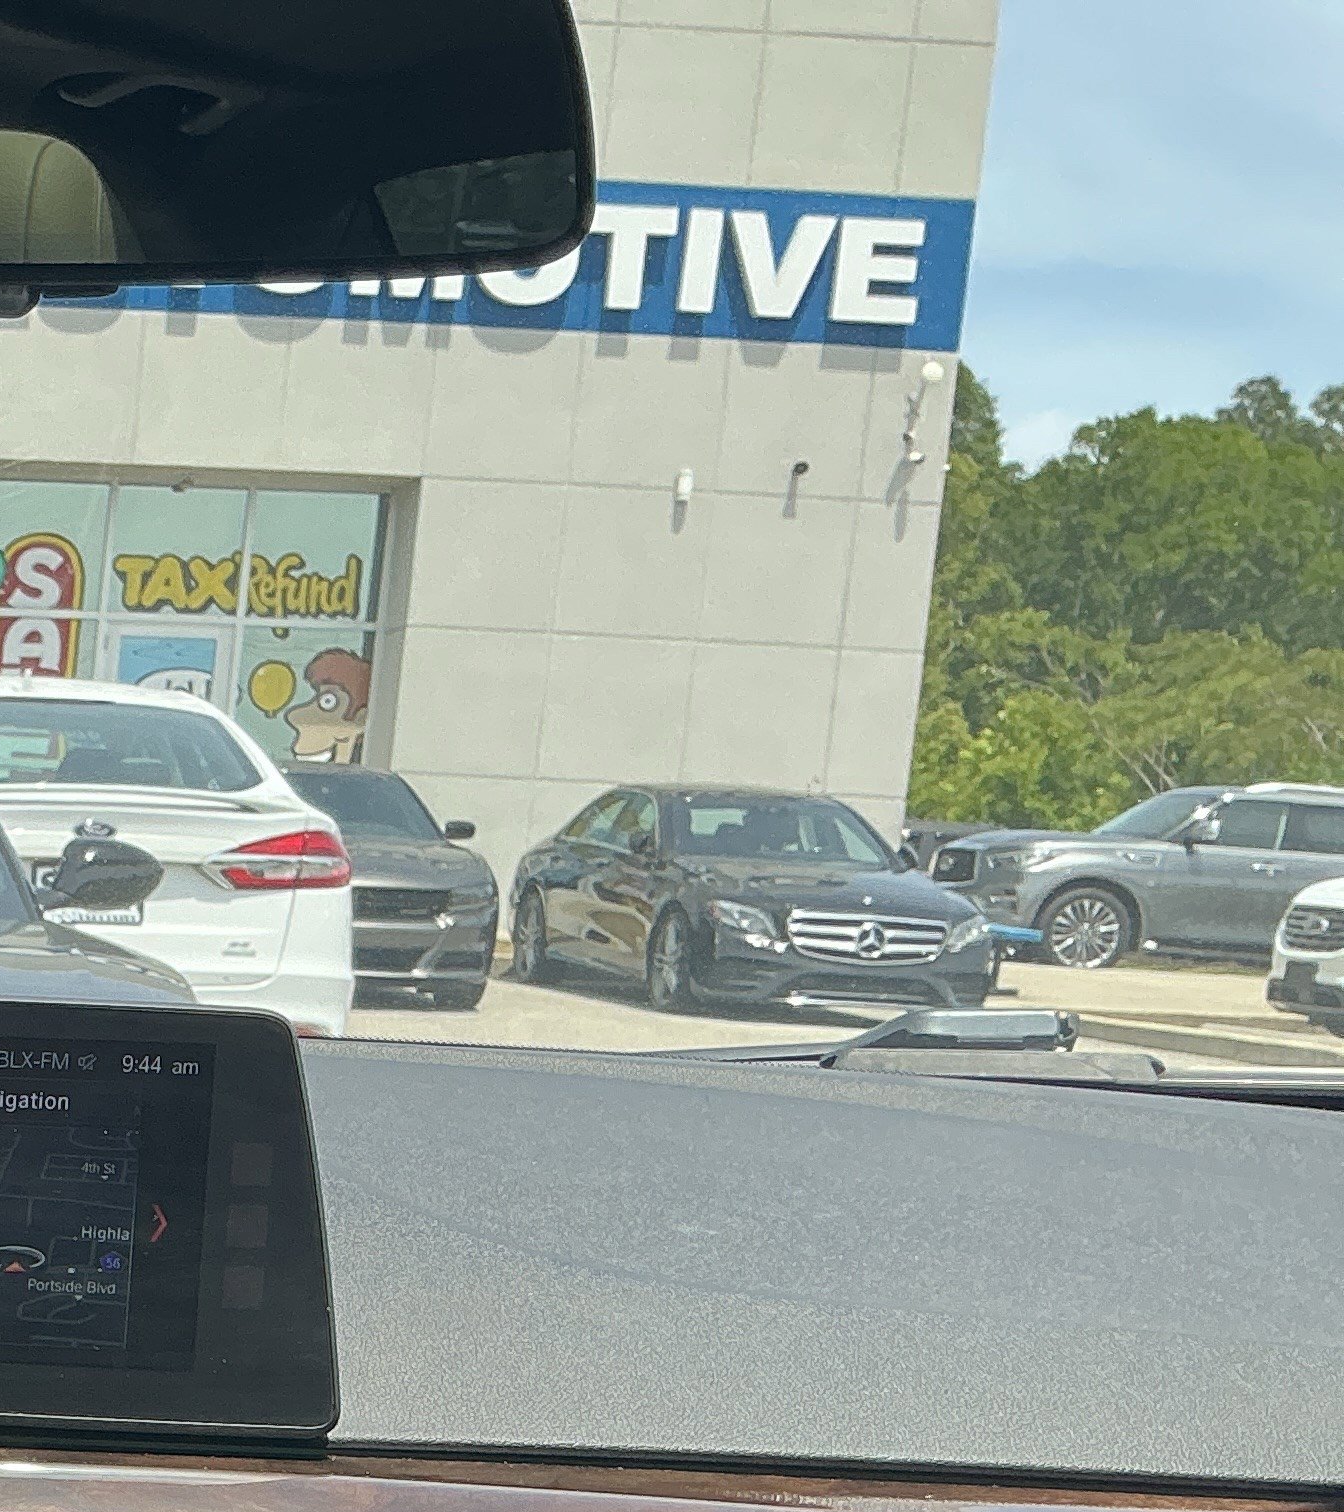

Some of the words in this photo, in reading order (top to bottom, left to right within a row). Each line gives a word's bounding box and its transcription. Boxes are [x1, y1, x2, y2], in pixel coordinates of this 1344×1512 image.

[114, 553, 240, 613] TAX
[122, 1055, 161, 1075] 9:44
[171, 1060, 199, 1075] am
[80, 1225, 130, 1242] Highla
[27, 1278, 83, 1294] Portside
